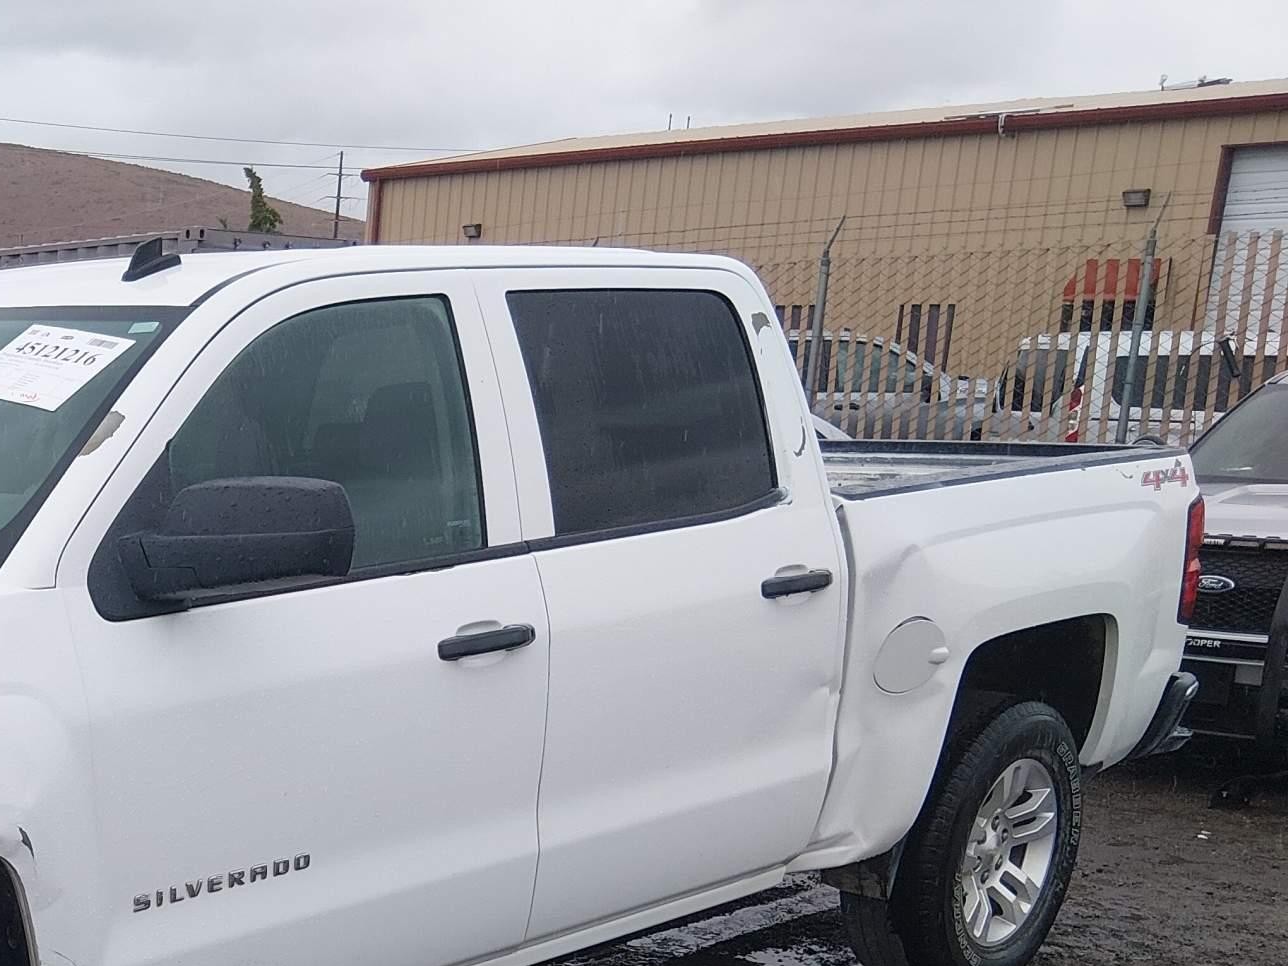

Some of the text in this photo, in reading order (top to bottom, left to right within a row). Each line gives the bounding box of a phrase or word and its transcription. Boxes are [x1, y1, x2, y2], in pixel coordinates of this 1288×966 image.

[16, 342, 103, 366] 45121216
[1198, 578, 1224, 589] Ford
[133, 853, 311, 913] SILVERADO
